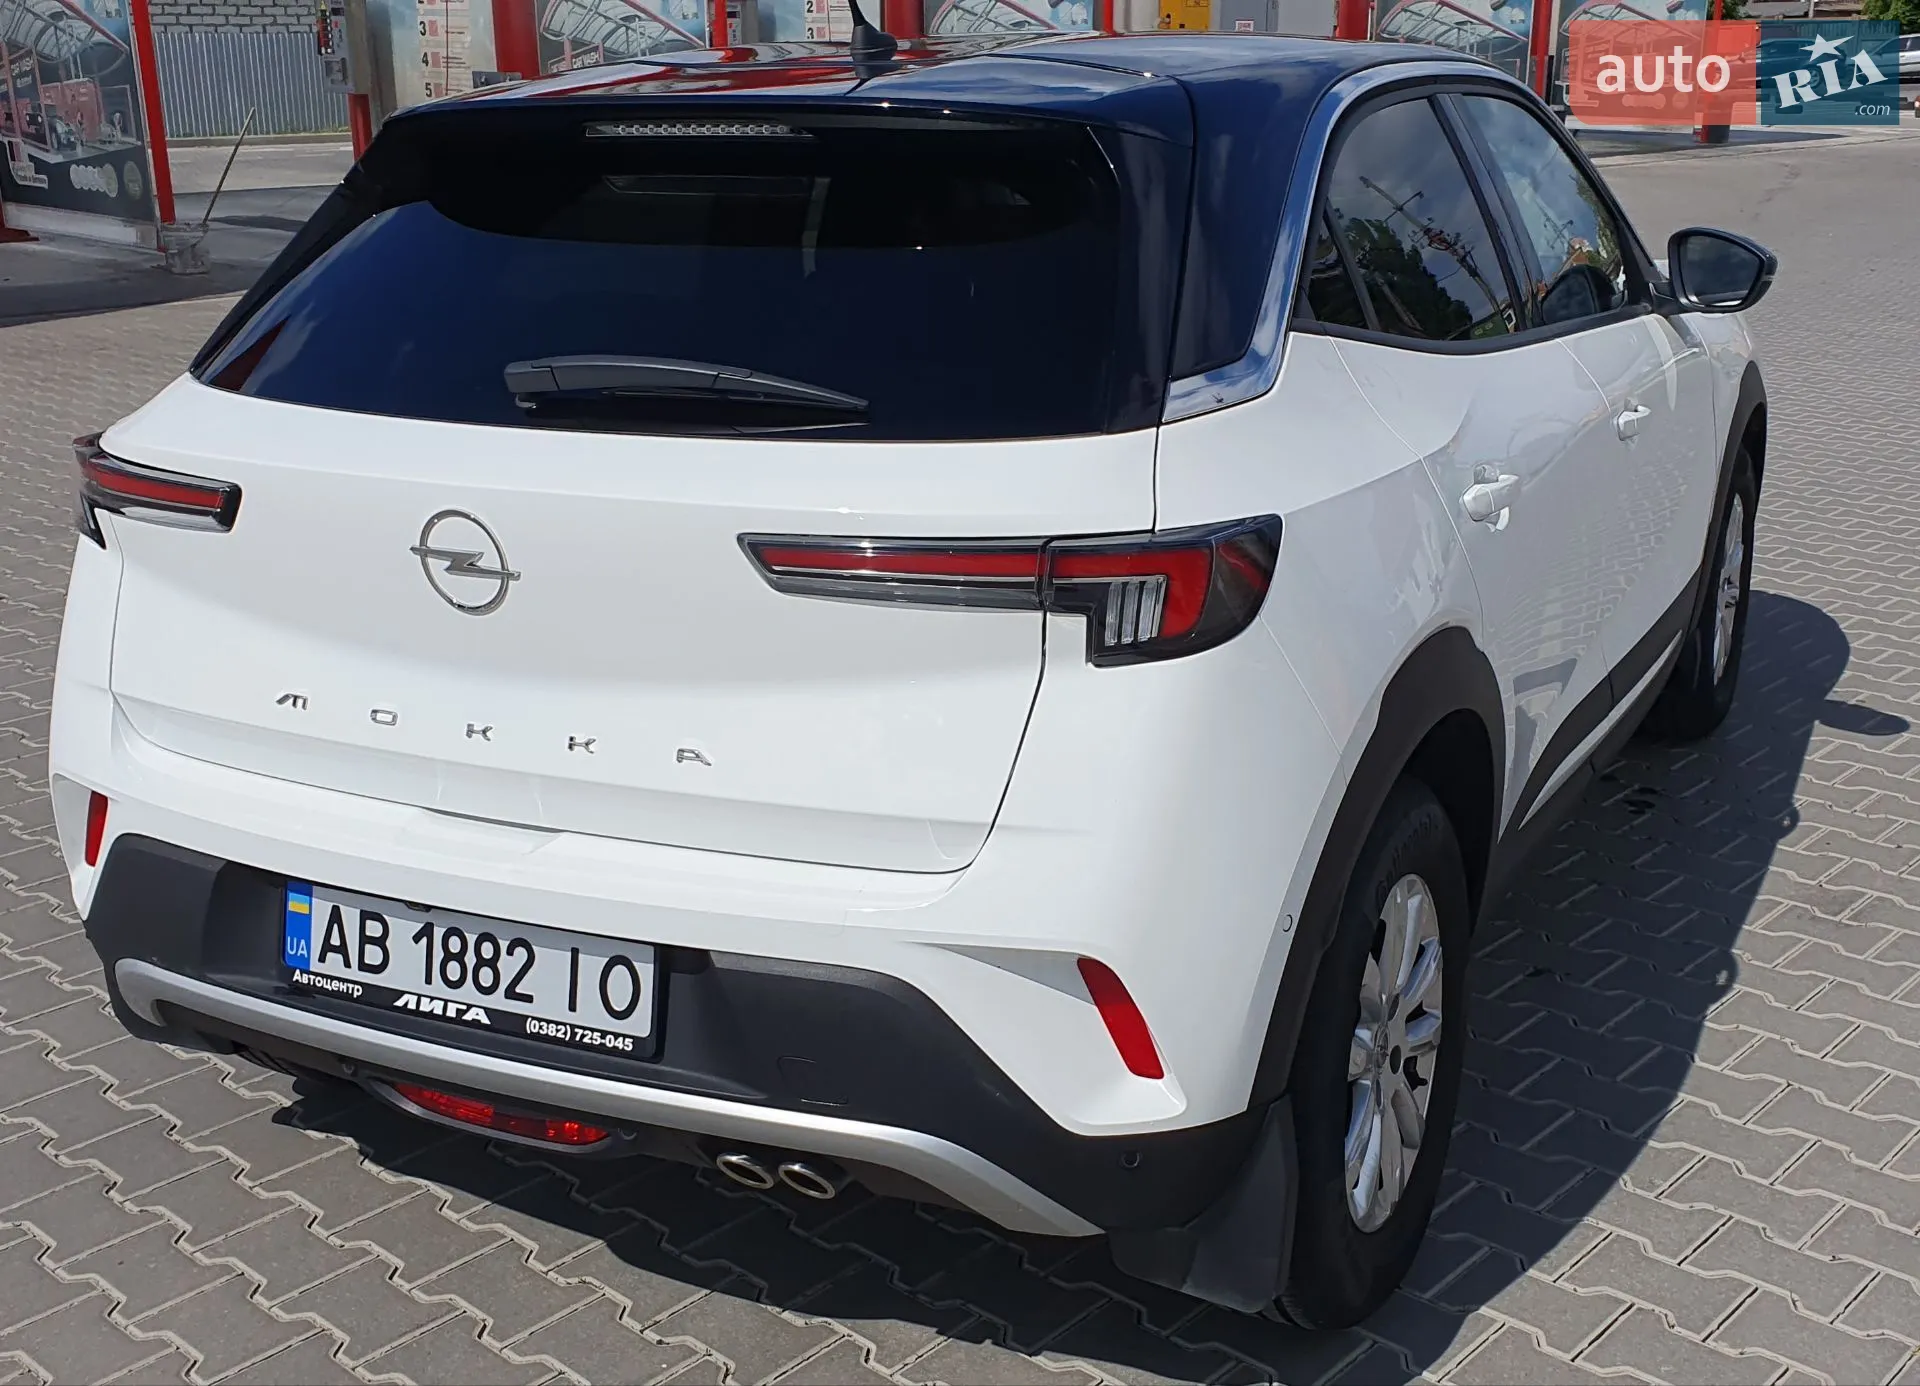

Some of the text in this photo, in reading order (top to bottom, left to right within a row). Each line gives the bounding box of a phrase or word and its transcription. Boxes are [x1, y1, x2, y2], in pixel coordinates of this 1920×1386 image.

[806, 1, 813, 13] 2
[419, 21, 427, 36] 3
[807, 27, 814, 39] 3
[421, 52, 429, 66] 4
[425, 83, 432, 98] 5
[275, 692, 713, 767] MOKKA
[287, 936, 308, 959] UA
[317, 904, 642, 1021] AB 1882 IO
[292, 969, 363, 999] Автоцентр
[392, 993, 492, 1026] ЛИГА
[526, 1016, 635, 1052] (0382) 725-045
